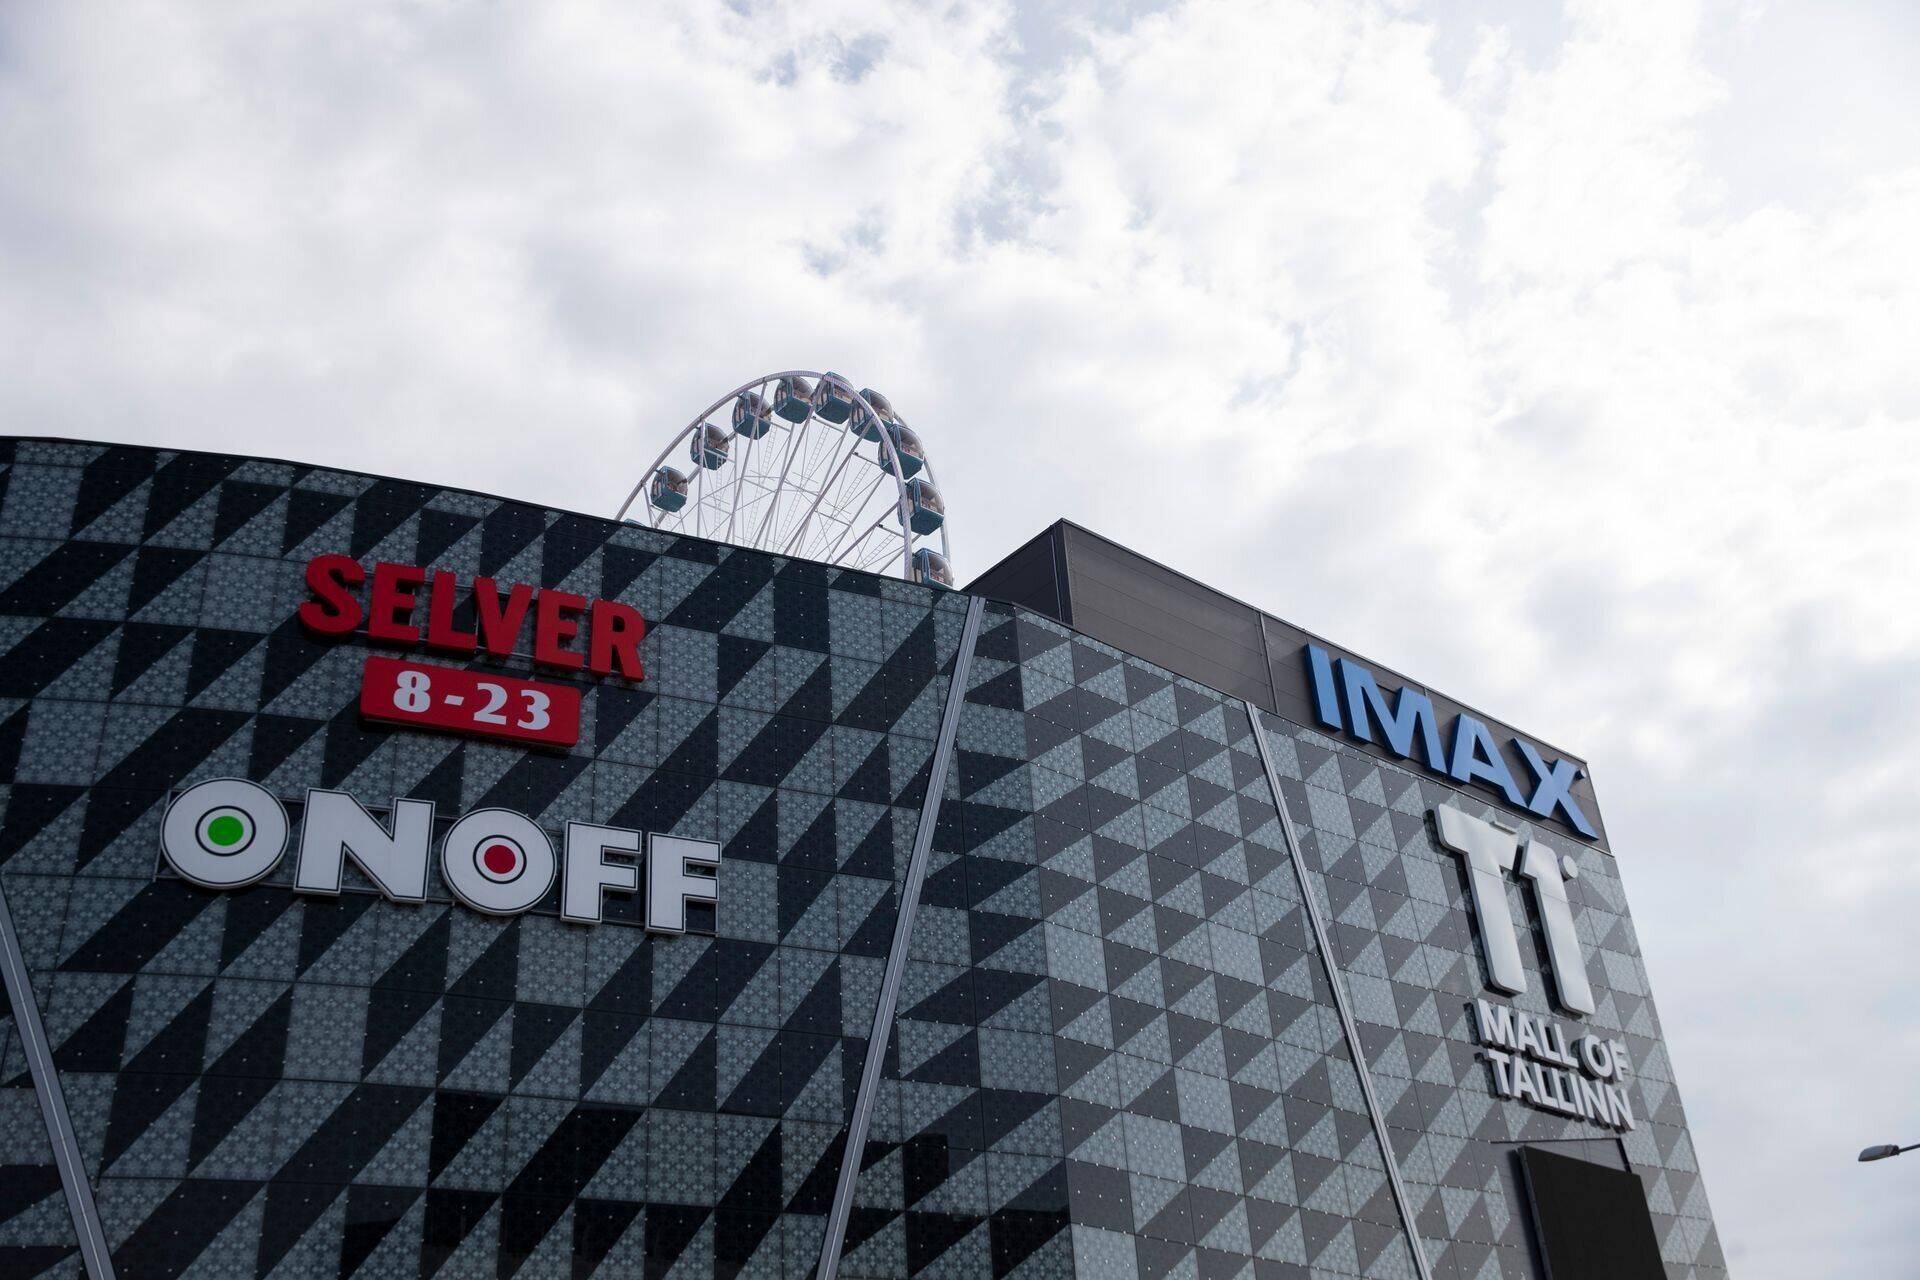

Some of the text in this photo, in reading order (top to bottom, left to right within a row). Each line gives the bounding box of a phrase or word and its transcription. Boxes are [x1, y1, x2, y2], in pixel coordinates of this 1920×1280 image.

[299, 554, 646, 682] SELVER
[1305, 643, 1599, 840] IMAX
[161, 777, 722, 933] ONOFF
[1434, 803, 1595, 1016] T1
[1476, 998, 1628, 1084] MALL OF
[1486, 1048, 1636, 1131] TALLINN
